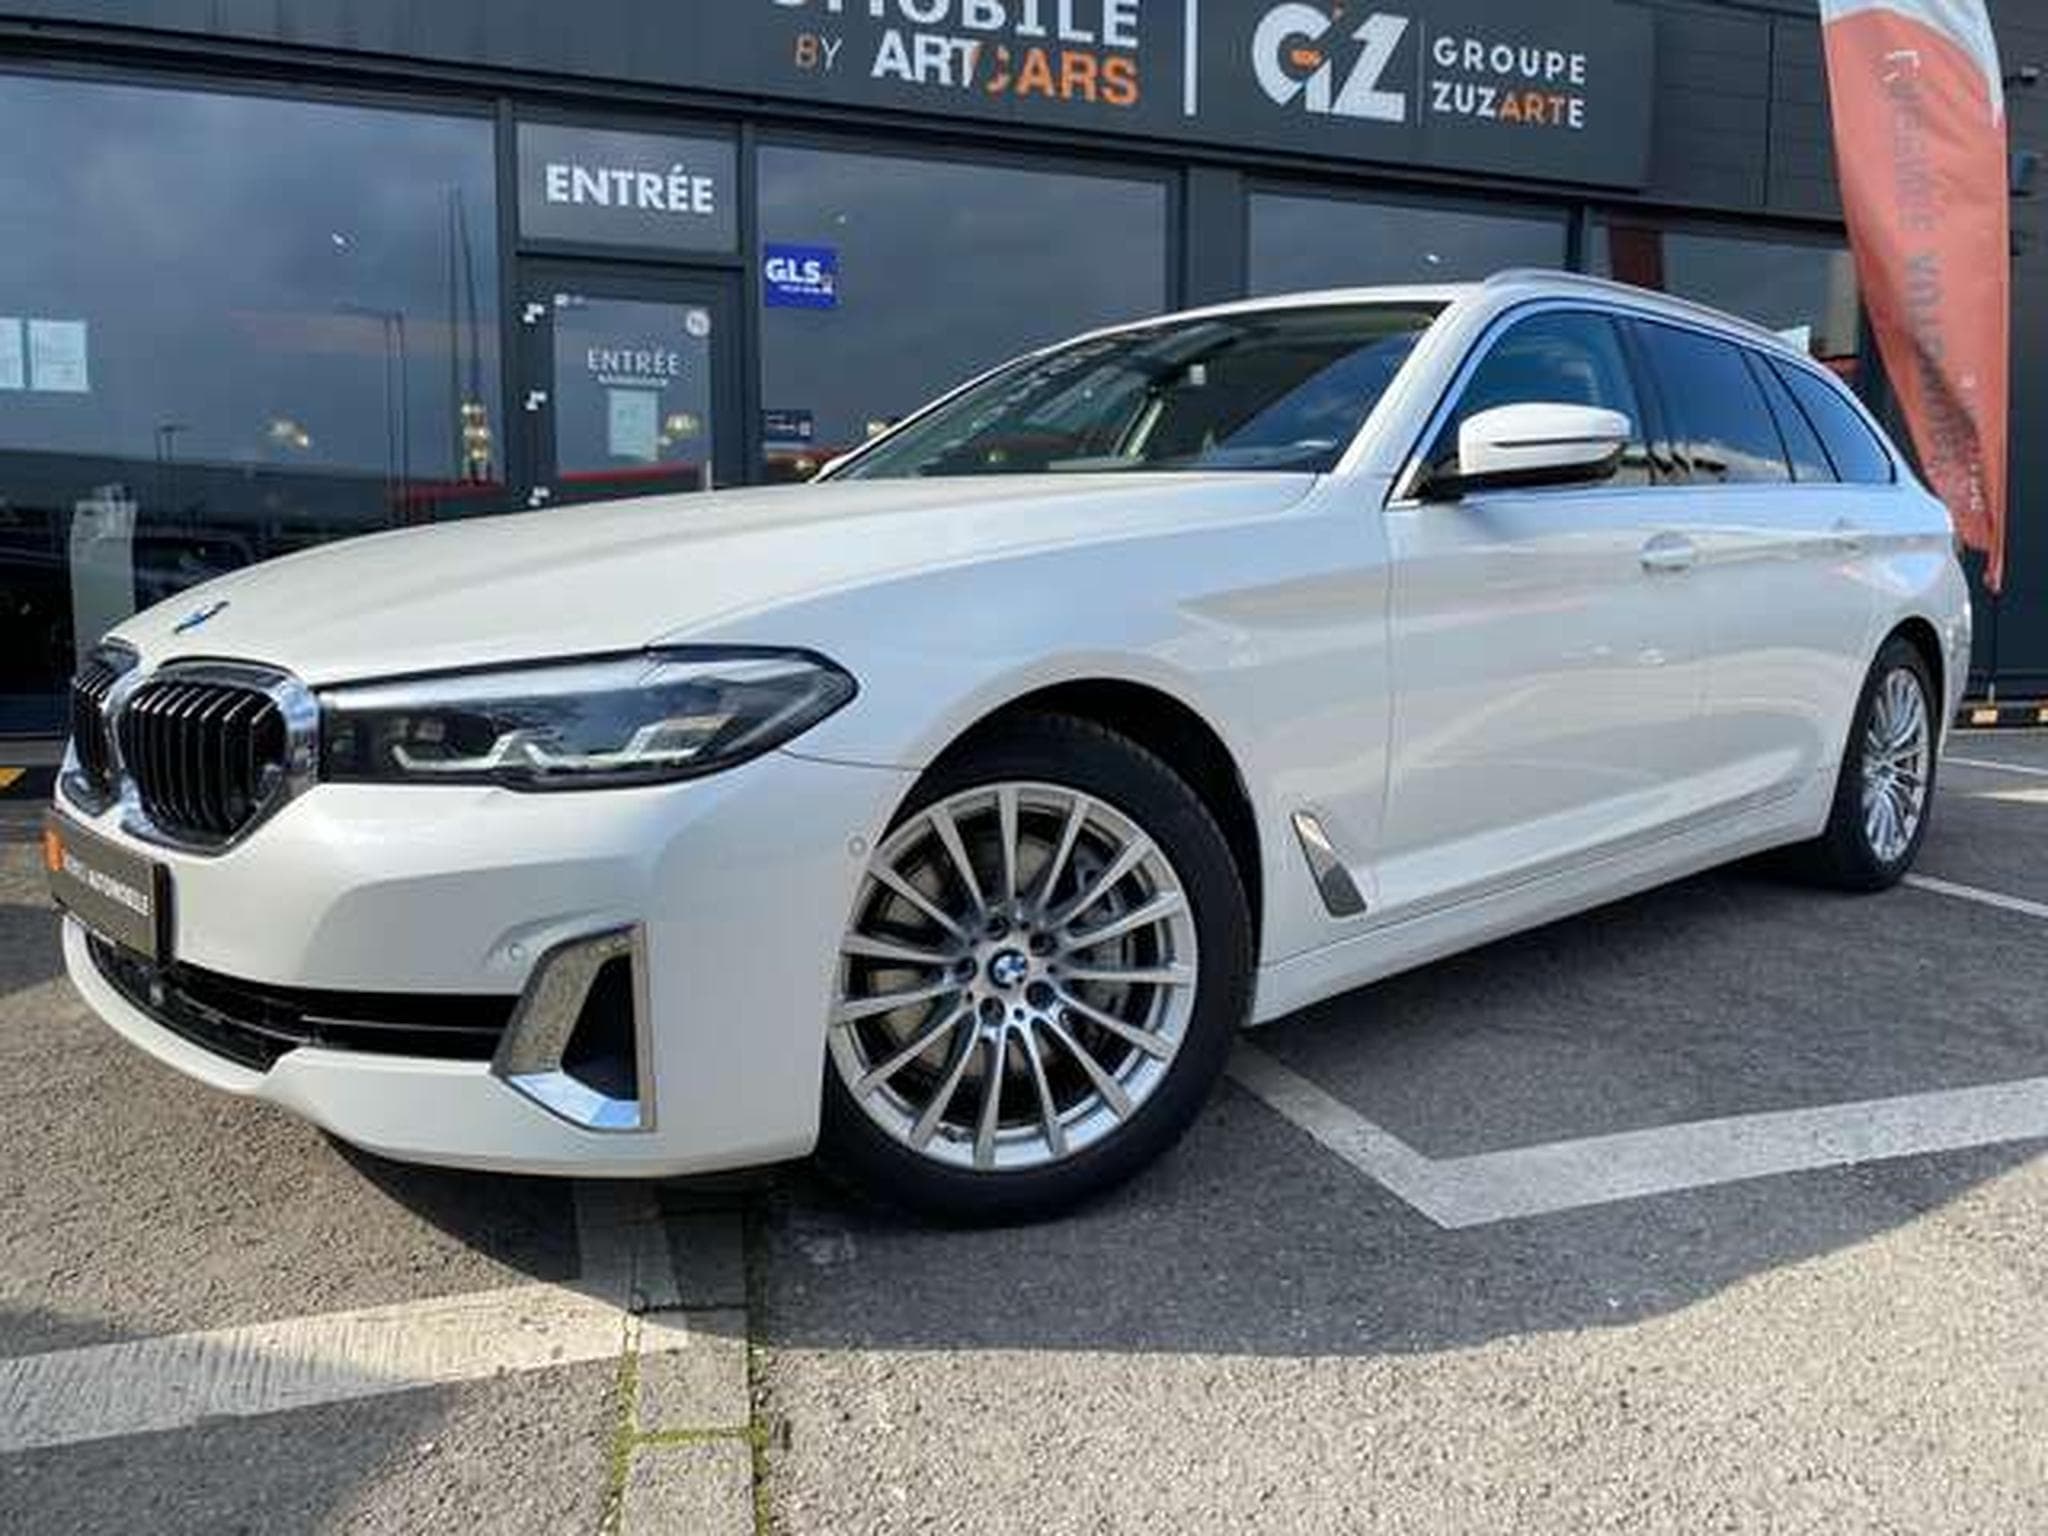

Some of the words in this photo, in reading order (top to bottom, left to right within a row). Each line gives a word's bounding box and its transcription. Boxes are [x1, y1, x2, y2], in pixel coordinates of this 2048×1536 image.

[796, 33, 842, 71] BY
[1433, 36, 1586, 84] GROUPE
[1432, 81, 1585, 129] ZUZARTE
[546, 163, 713, 214] ENTRÉE
[766, 258, 820, 283] GLS
[587, 346, 679, 375] ENTRÉE
